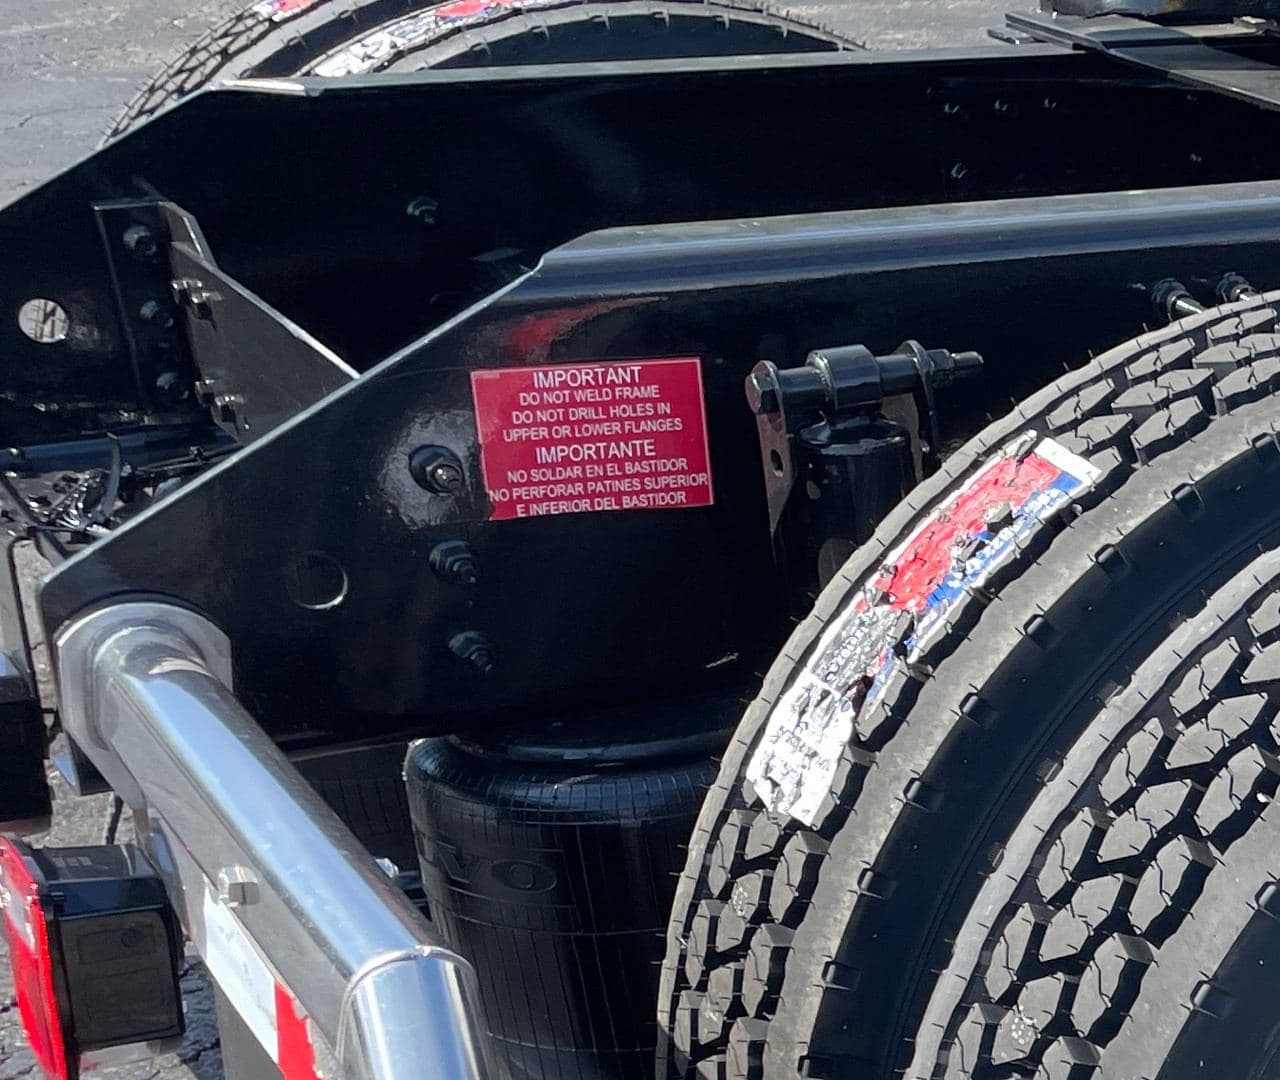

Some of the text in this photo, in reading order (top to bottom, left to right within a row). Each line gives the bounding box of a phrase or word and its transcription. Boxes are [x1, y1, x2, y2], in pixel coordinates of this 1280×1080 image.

[533, 366, 642, 389] IMPORTANT
[520, 385, 660, 406] DO NOT WELD FRAME
[512, 402, 671, 424] DO NOT DRILL HOLES IN
[503, 417, 683, 442] UPPER OR LOWER FLANGES
[536, 439, 655, 464] IMPORTANTE
[507, 458, 688, 483] NO SOLDAR EN EL BASTIDOR
[489, 473, 708, 502] NO PERFORAR PATINES SUPERIOR
[516, 491, 686, 517] E INFERIOR DEL BASTIDOR
